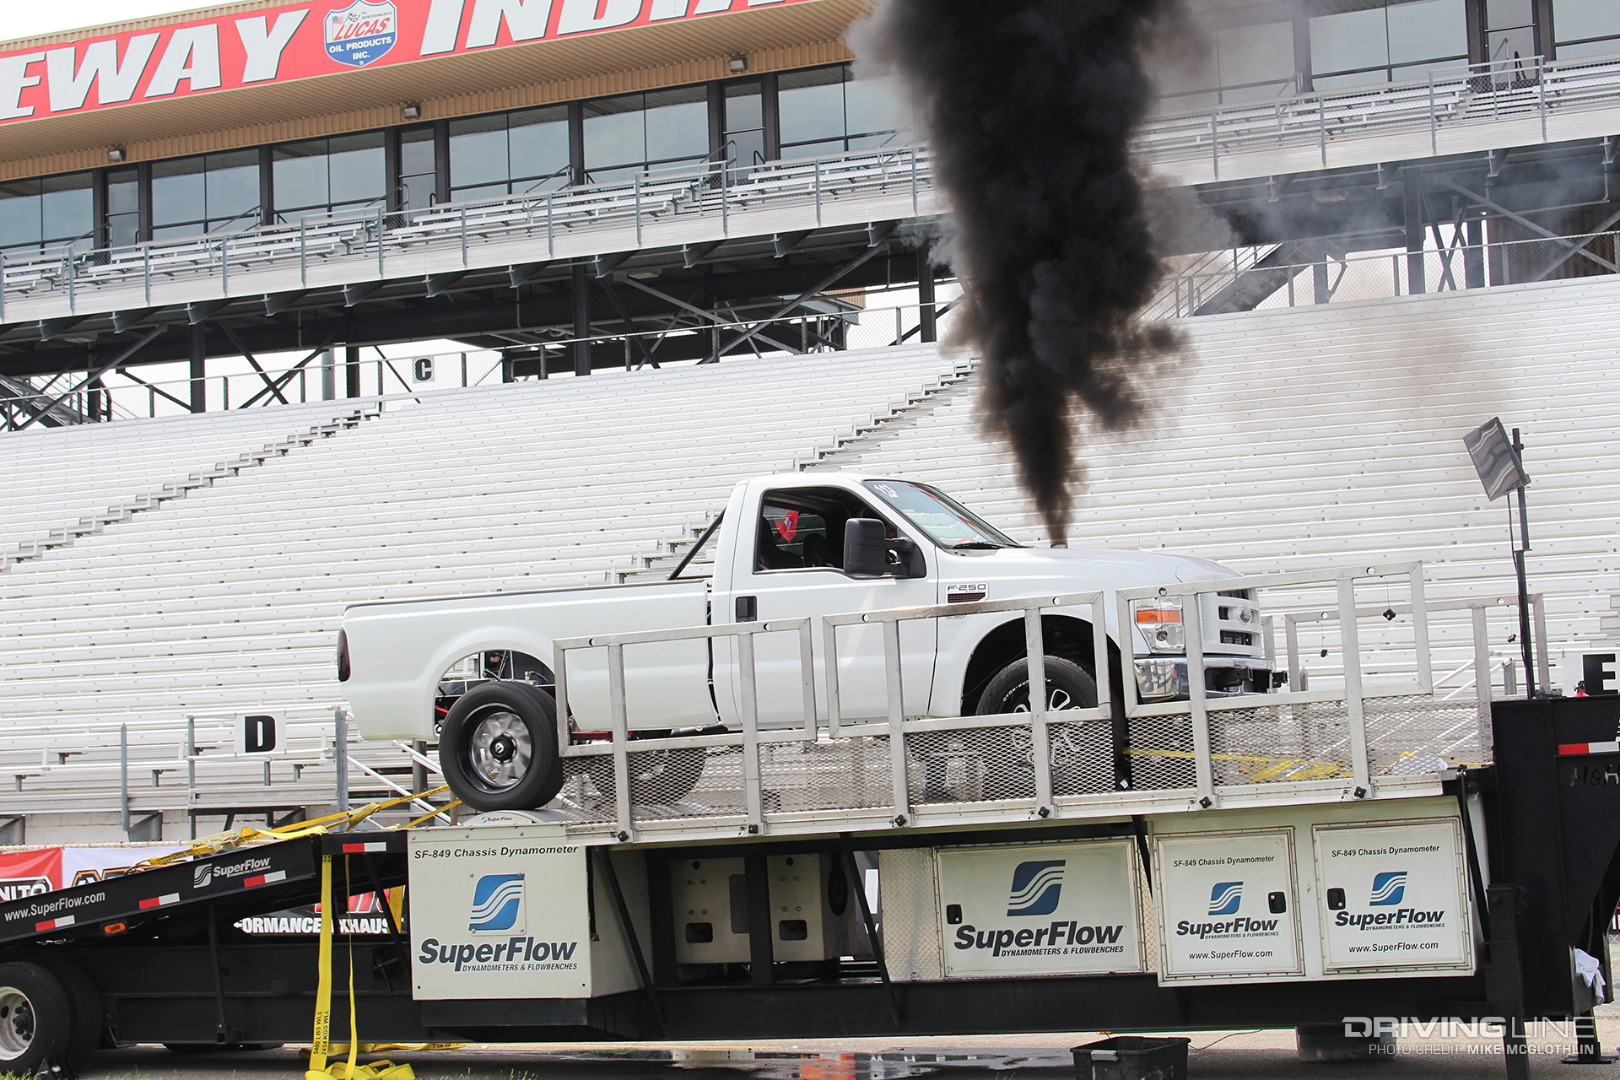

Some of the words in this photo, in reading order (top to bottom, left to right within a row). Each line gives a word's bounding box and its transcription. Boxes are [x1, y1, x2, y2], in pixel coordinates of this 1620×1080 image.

[333, 17, 390, 41] LUCAS
[329, 45, 344, 53] OIL
[346, 36, 392, 51] PRODUCTS
[352, 51, 370, 60] INC.
[415, 359, 432, 381] C
[1583, 653, 1618, 695] E
[245, 715, 276, 753] D
[414, 849, 451, 859] SF-849
[454, 847, 497, 858] Chassis
[500, 845, 579, 857] Dynamometer
[1331, 849, 1357, 858] SF-849
[1358, 847, 1387, 856] Chassis
[1388, 844, 1440, 855] Dynamometer
[213, 857, 271, 878] SuperFlow
[1173, 859, 1197, 867] SF-849
[1198, 857, 1226, 866] Chassis
[1227, 855, 1275, 865] Dynamometer
[5, 892, 106, 921] www.SuperFlow.com
[241, 917, 322, 934] ORMANCE
[1176, 917, 1279, 939] SuperFlow
[1335, 908, 1445, 931] SuperFlow
[954, 921, 1123, 957] SuperFlow
[1349, 941, 1439, 954] www.SuperFlow.com
[418, 937, 578, 972] SuperFlow
[1001, 948, 1061, 957] DYNAMOMETERS
[1063, 947, 1069, 955] &
[1070, 945, 1124, 954] FLOWBENCHES
[1188, 949, 1273, 960] www.SuperFlow.com
[462, 963, 519, 972] DYNAMOMETERS
[520, 963, 526, 971] &
[527, 962, 578, 971] FLOWBENCHES
